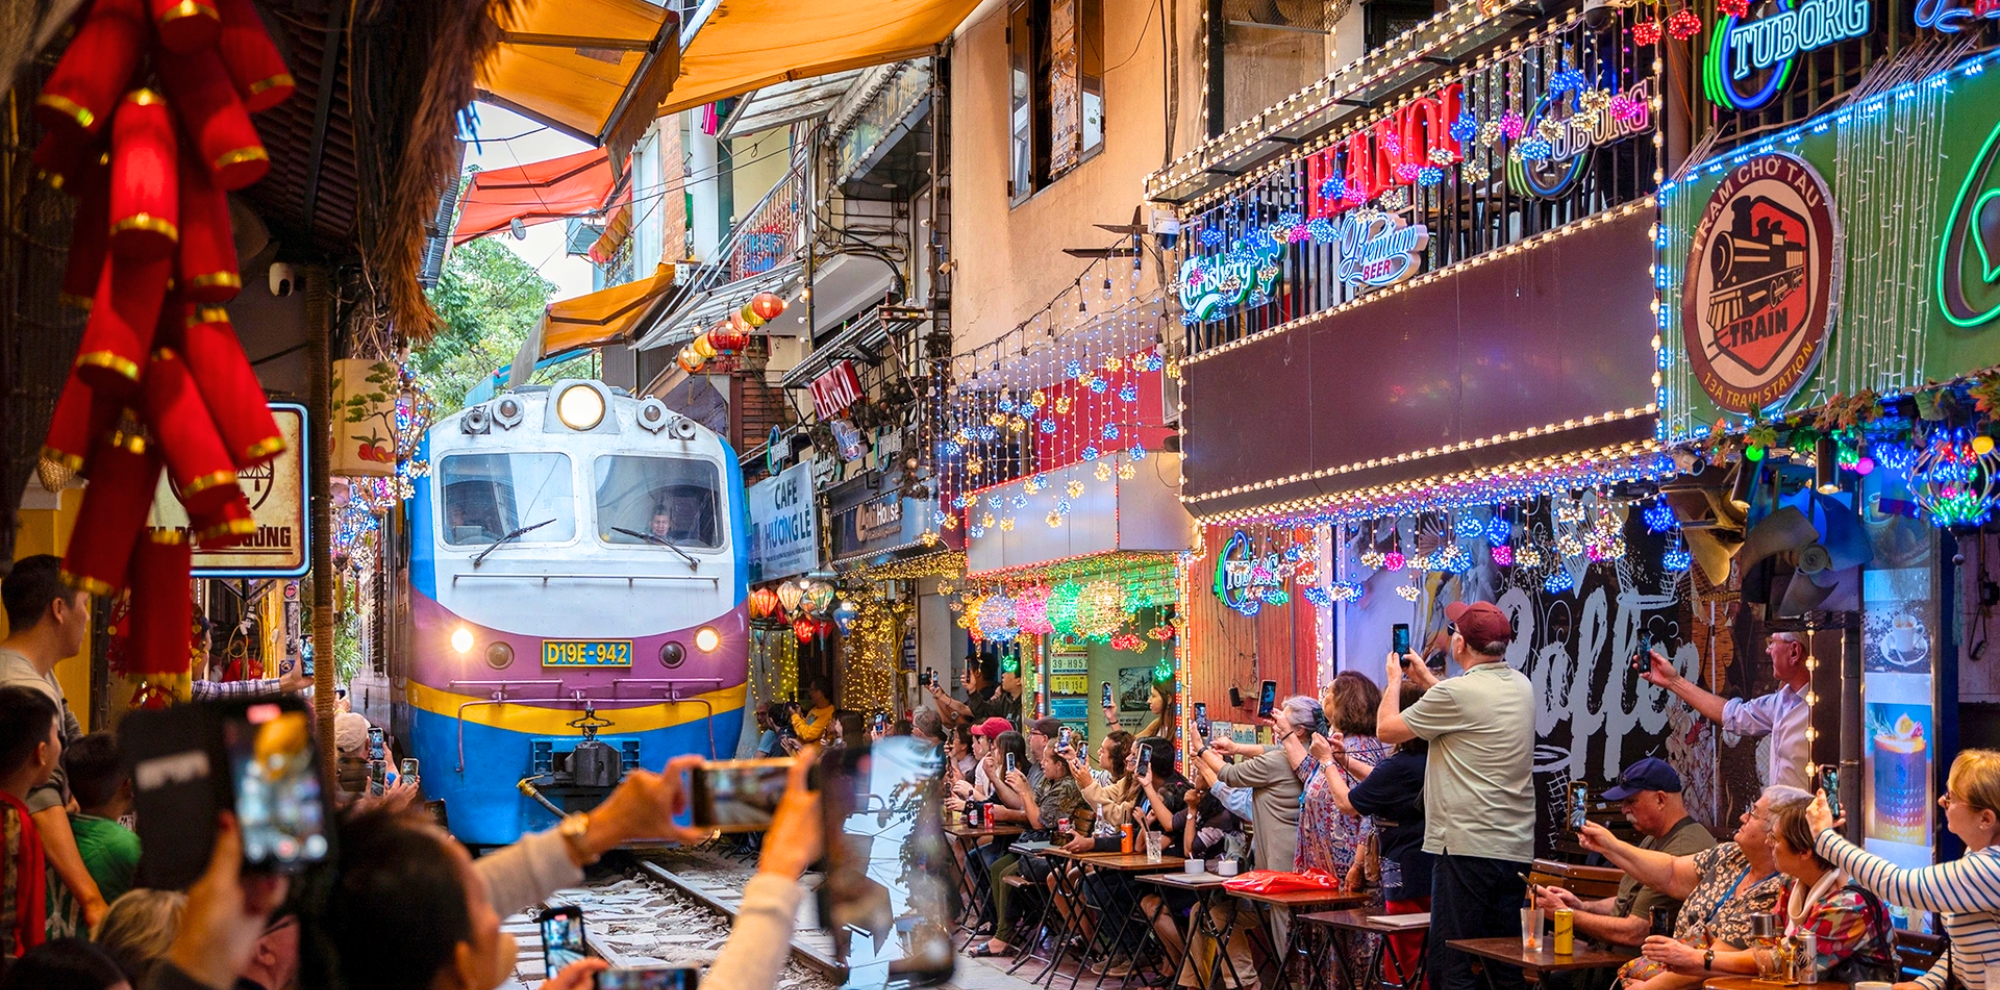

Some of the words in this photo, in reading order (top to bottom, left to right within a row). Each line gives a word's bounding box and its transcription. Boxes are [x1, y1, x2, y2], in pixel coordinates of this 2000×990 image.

[1731, 0, 1869, 79] TUBORG
[1306, 84, 1464, 219] HANOI
[1692, 179, 1734, 253] TRẠM
[1738, 155, 1782, 184] CHỜ
[1787, 162, 1820, 208] TÀU
[1338, 214, 1418, 279] Premium
[1362, 259, 1392, 281] BEER
[1728, 307, 1788, 348] TRAIN
[1703, 372, 1723, 396] 13A
[1726, 389, 1762, 408] TRAIN
[1764, 341, 1813, 401] STATION
[775, 477, 798, 511] CAFE
[799, 503, 812, 539] LÊ
[547, 643, 628, 663] D19E-942
